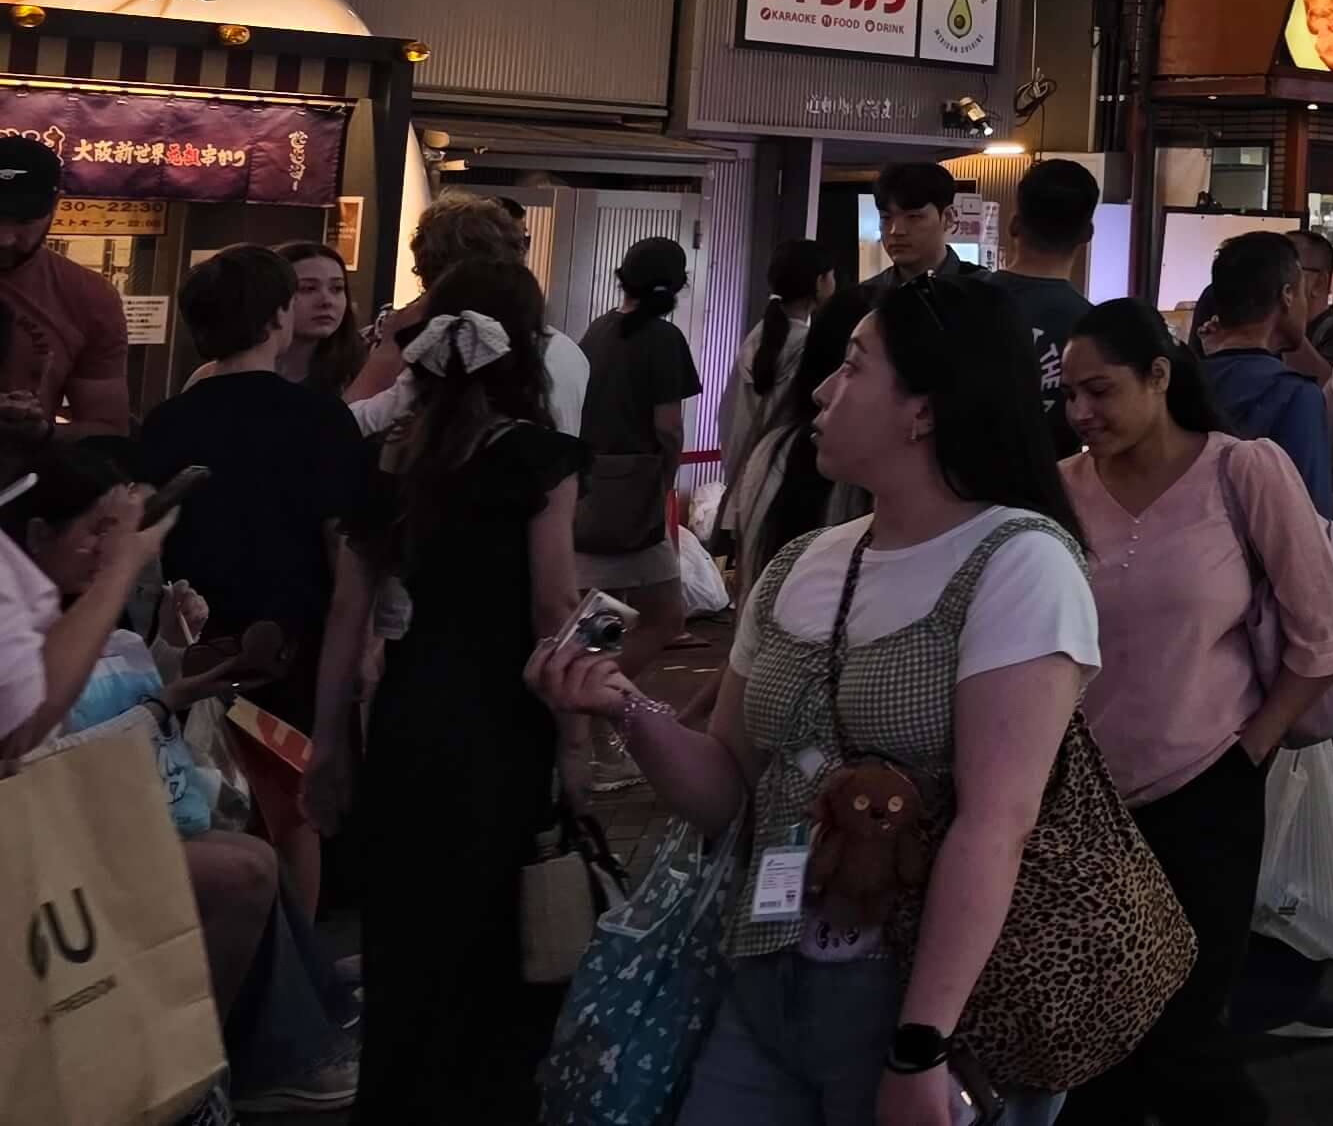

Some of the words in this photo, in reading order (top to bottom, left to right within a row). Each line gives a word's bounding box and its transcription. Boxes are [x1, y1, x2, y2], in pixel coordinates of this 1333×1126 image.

[771, 9, 818, 26] KARAOKE
[833, 16, 861, 31] FOOD
[876, 22, 905, 35] DRINK
